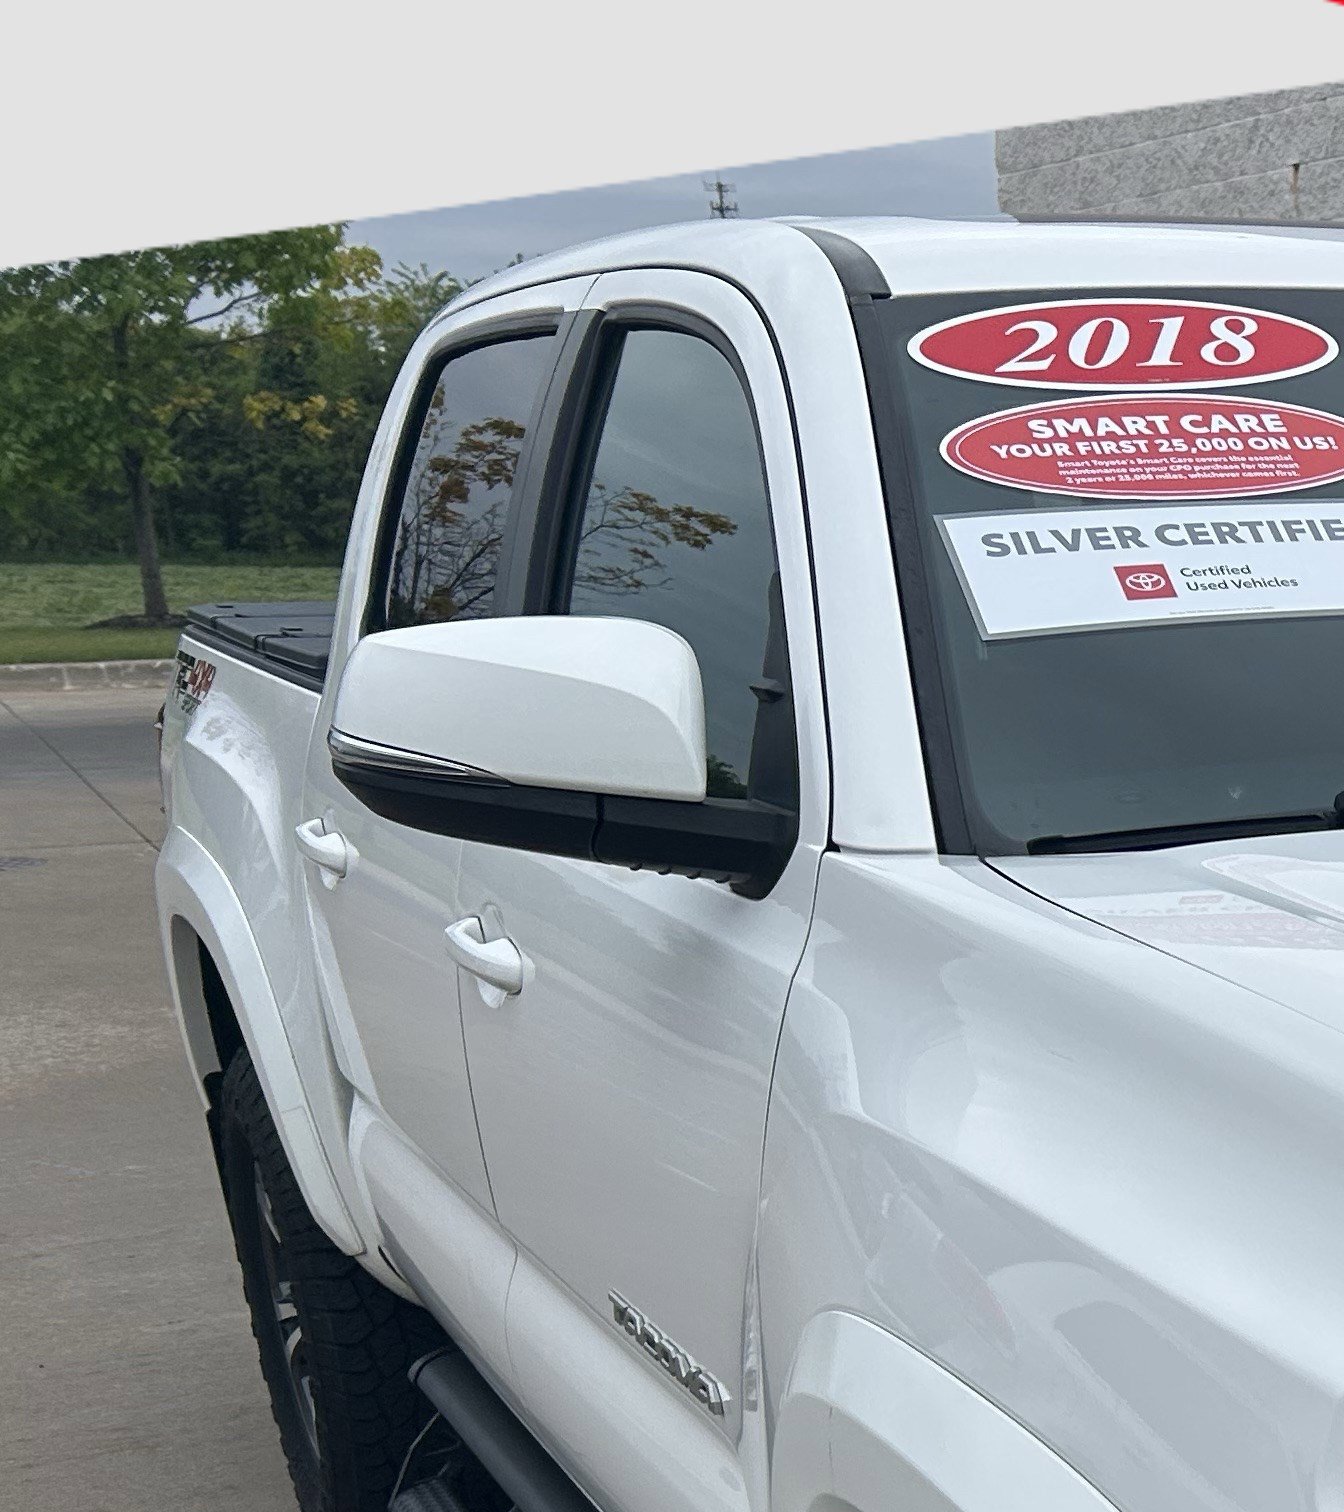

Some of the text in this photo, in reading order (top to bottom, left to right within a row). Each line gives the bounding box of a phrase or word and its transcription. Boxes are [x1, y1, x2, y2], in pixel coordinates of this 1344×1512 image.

[994, 315, 1258, 373] 2018
[1027, 412, 1288, 440] SMART CARE
[989, 433, 1339, 460] YOUR FIRST 25,000 ON US!
[980, 525, 1150, 559] SILVER
[1180, 563, 1251, 578] Certified
[1186, 575, 1298, 592] Used Vehicles
